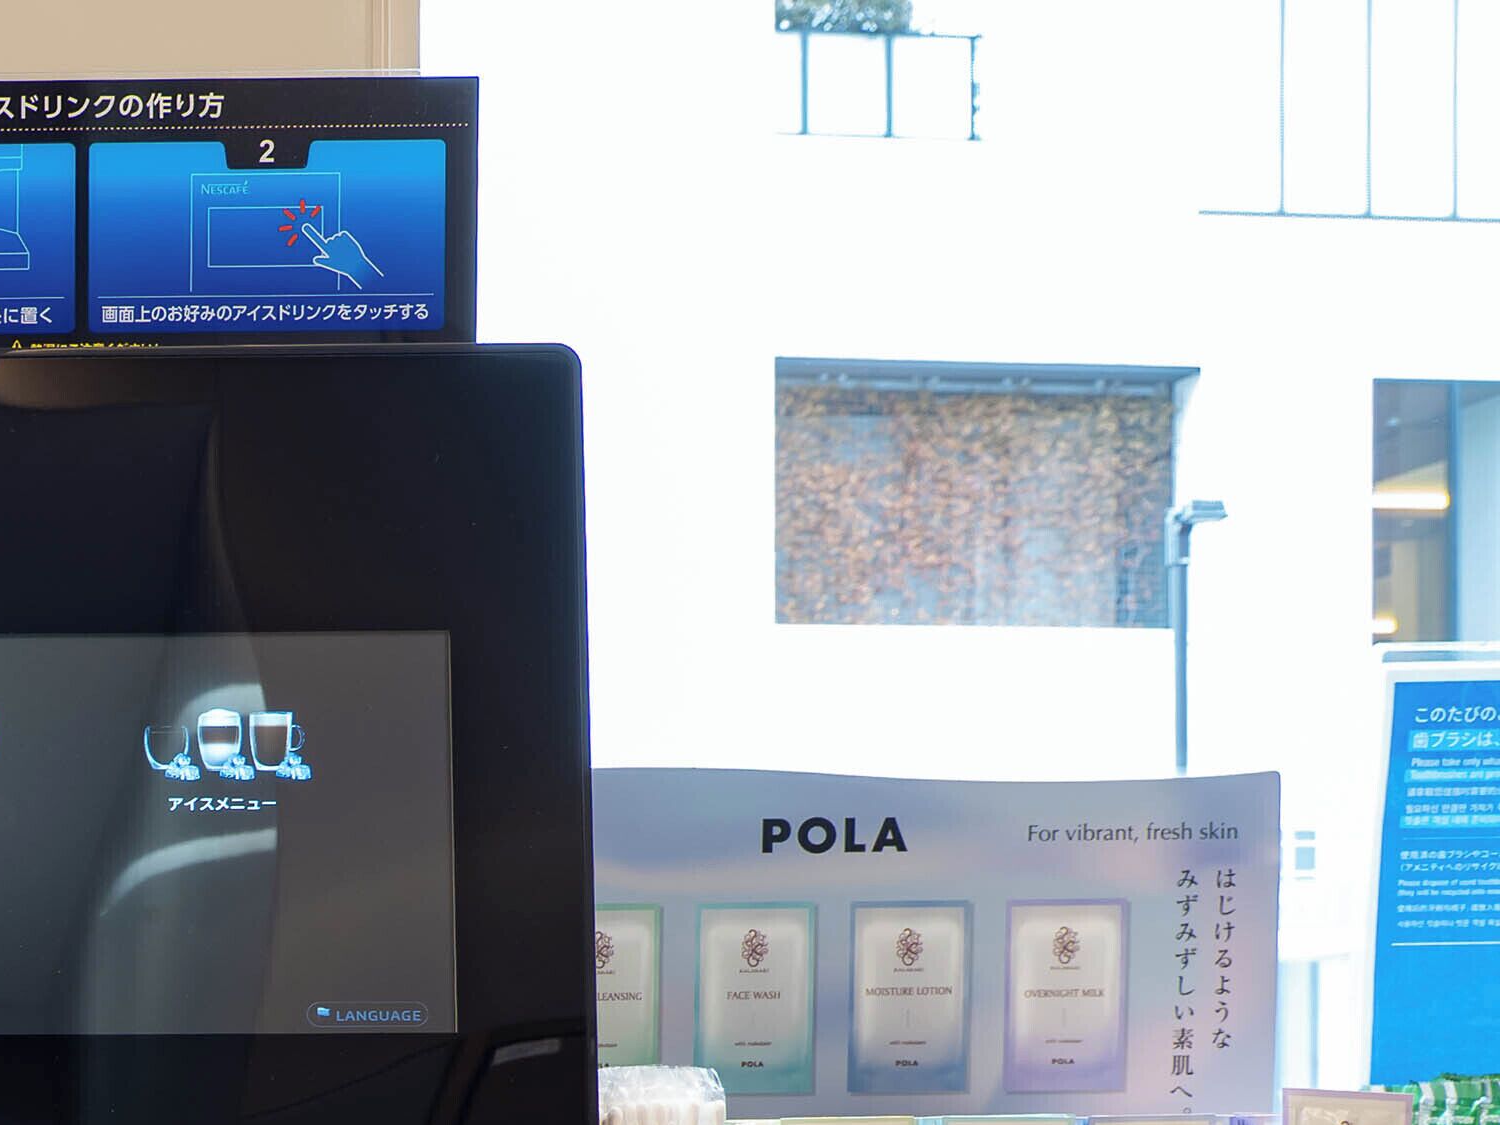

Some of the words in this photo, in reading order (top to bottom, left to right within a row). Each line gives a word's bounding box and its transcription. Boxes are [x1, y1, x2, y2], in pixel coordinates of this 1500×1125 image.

[259, 140, 275, 163] 2
[101, 304, 430, 324] 画面上のお好みのアイスドリンクをタッチする
[1415, 705, 1500, 723] このたびの
[168, 797, 277, 811] アイスメニュー
[761, 817, 909, 854] POLA
[1027, 825, 1059, 842] For
[1065, 823, 1139, 844] vibrant,
[1146, 821, 1193, 840] fresh
[1199, 821, 1239, 840] skin
[1211, 869, 1237, 1049] はじけるような
[598, 992, 643, 1001] LEANSING
[727, 991, 751, 1000] FACE
[752, 991, 781, 1000] WASH
[865, 987, 914, 997] MOISTURE
[917, 986, 953, 996] LOTION
[1024, 989, 1079, 999] OVERNIGHT
[1081, 988, 1105, 998] MILK
[1170, 869, 1199, 1114] みずみずしい素肌へ。
[336, 1010, 421, 1022] LANGUAGE
[895, 1059, 919, 1067] POLA
